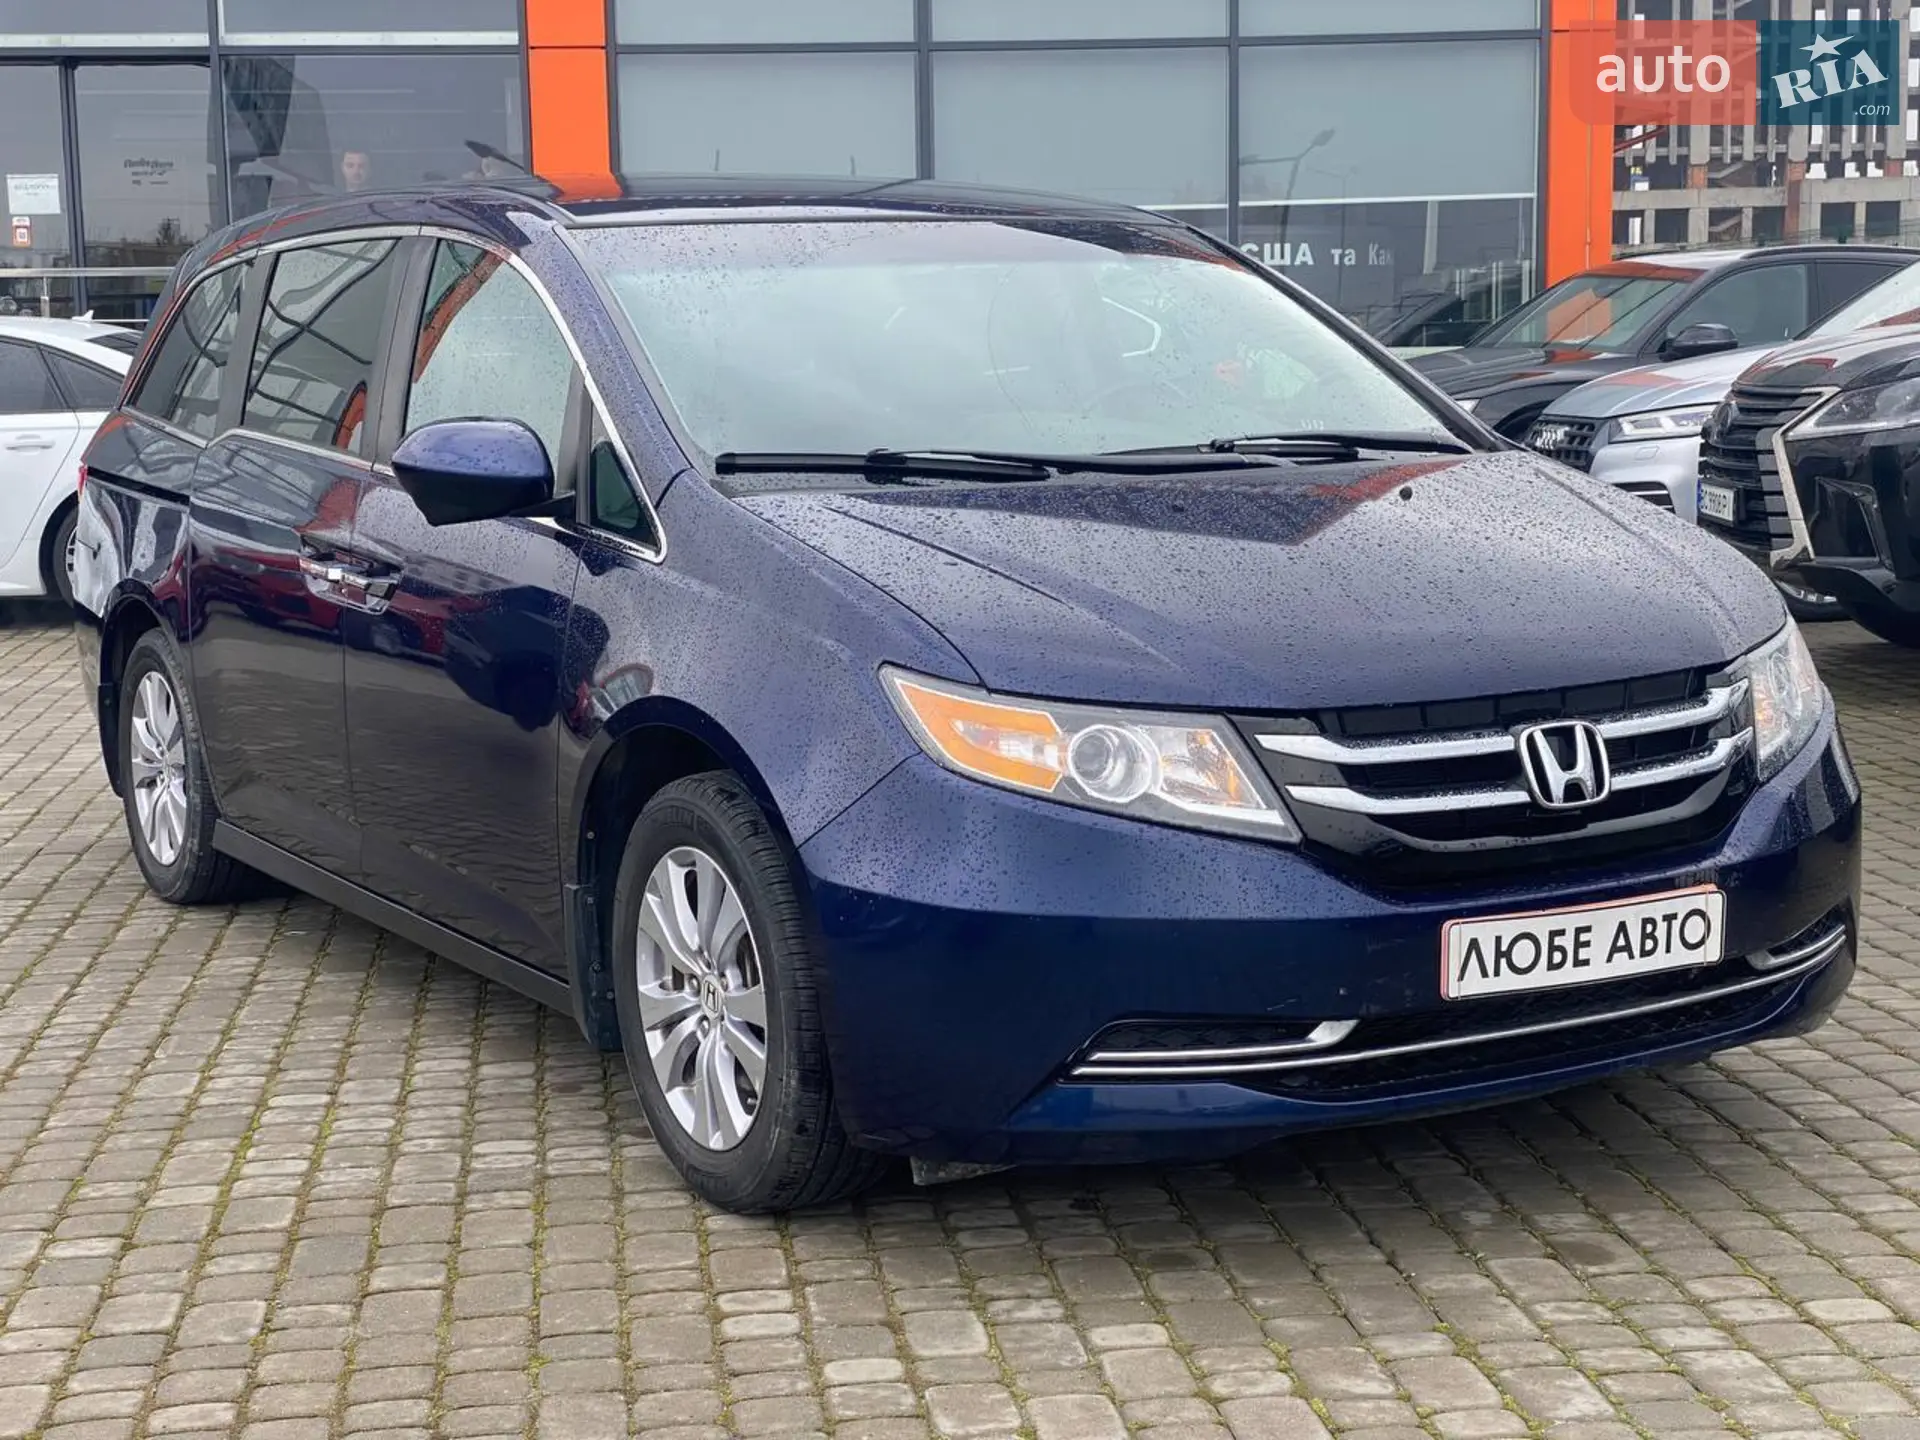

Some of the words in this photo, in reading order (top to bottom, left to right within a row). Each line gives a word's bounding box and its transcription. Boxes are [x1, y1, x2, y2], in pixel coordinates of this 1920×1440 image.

[1239, 242, 1315, 266] США
[1331, 247, 1356, 266] та
[1457, 924, 1593, 982] ЛЮБЕ
[1605, 907, 1712, 964] АВТО
